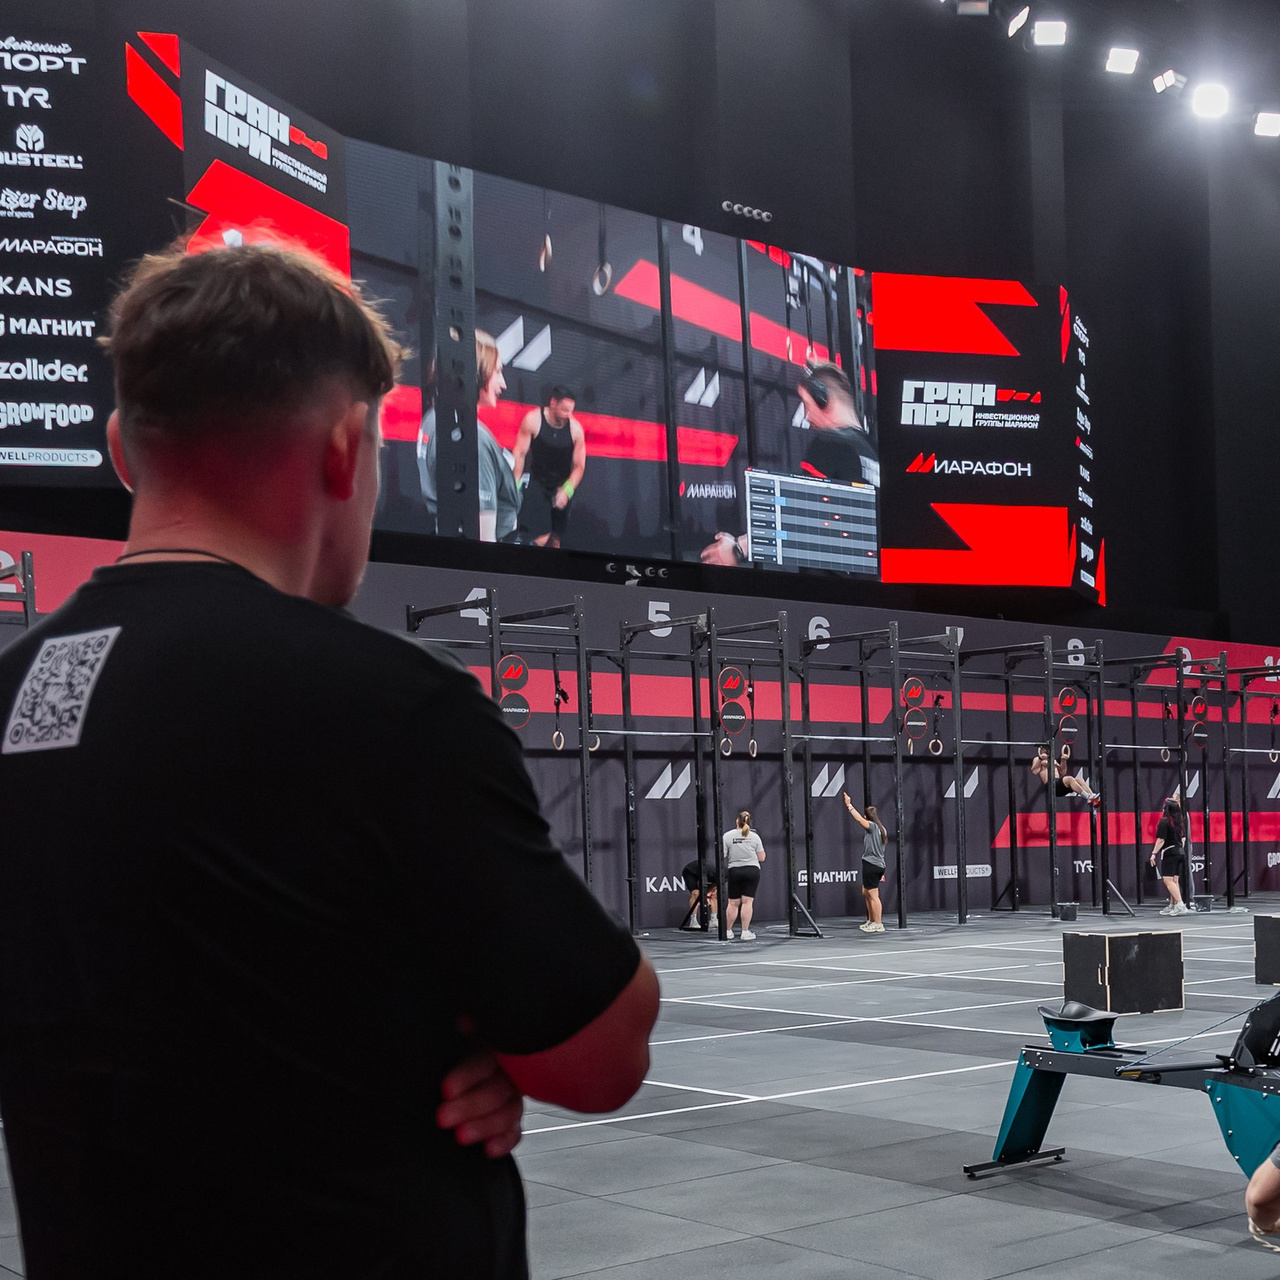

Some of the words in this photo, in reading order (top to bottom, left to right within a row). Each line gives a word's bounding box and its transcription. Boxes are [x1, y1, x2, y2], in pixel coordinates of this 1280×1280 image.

[1, 84, 52, 109] TYR
[205, 69, 290, 146] ГРАН
[204, 100, 271, 166] ПРИ
[43, 188, 87, 219] Step
[0, 238, 104, 257] МАРАФОН
[683, 224, 704, 256] 4
[0, 276, 73, 297] KANS
[9, 317, 96, 337] МАГНИТ
[902, 380, 996, 406] ГРАН
[900, 402, 974, 428] ПРИ
[975, 412, 1040, 422] ИНВЕСТИЦИОННОЙ
[975, 419, 1004, 427] ГРУППЫ
[1004, 421, 1039, 429] МАРАФОН
[460, 587, 490, 626] 4
[648, 600, 673, 638] 5
[808, 616, 831, 650] 6
[1067, 638, 1086, 667] 8
[646, 875, 687, 893] KAN
[813, 870, 859, 883] МАГНИТ
